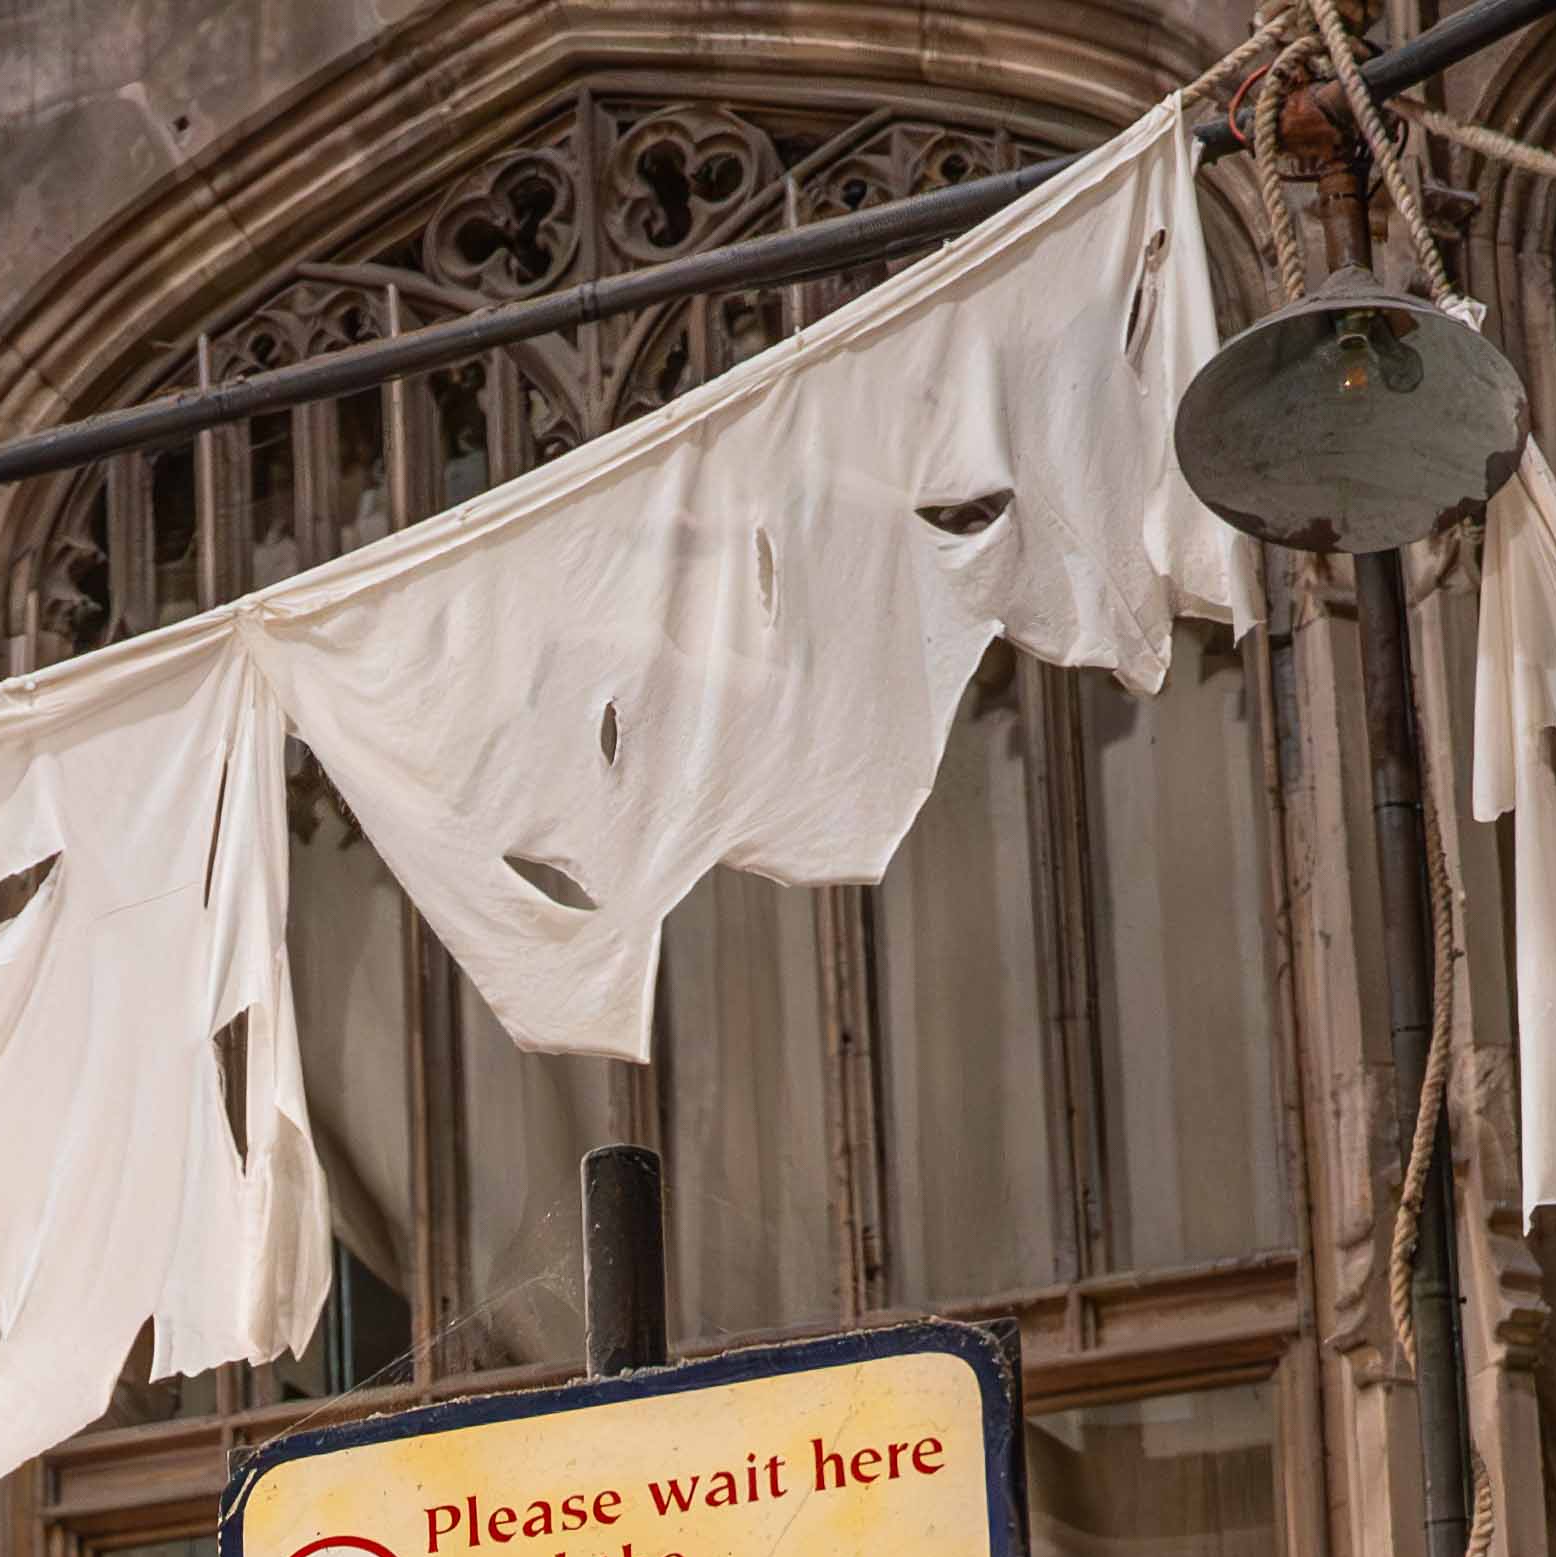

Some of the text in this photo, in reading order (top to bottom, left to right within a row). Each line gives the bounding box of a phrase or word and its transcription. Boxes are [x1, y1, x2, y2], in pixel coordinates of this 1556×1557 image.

[423, 1437, 946, 1554] Please wait here
